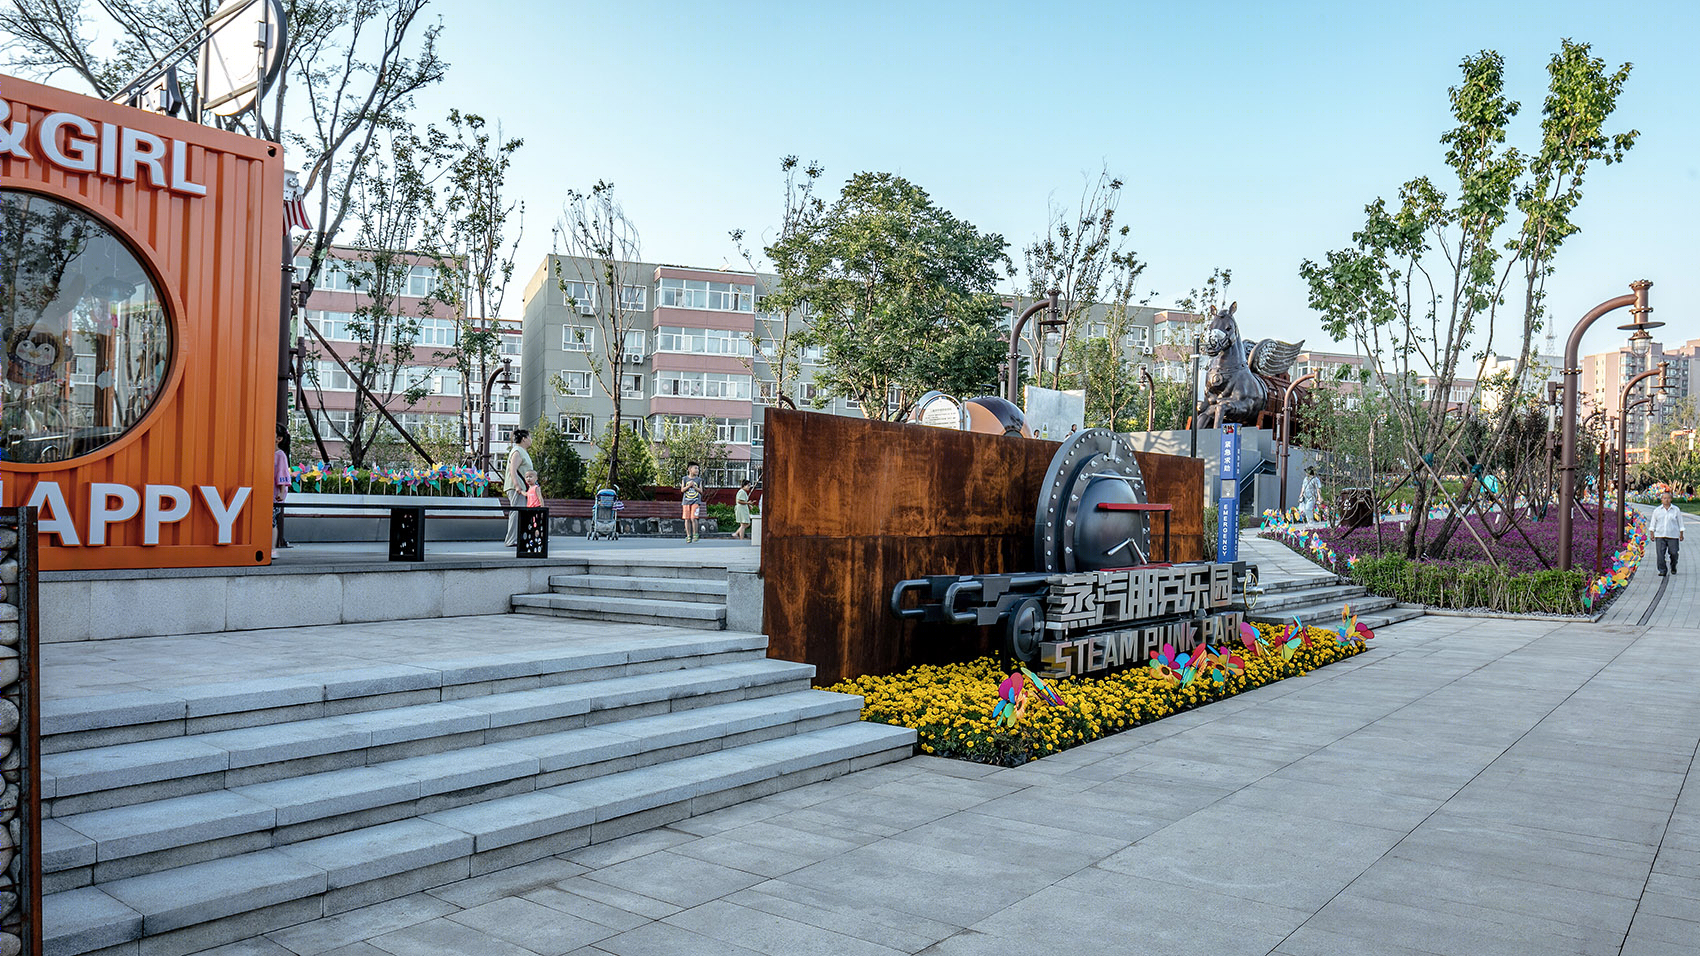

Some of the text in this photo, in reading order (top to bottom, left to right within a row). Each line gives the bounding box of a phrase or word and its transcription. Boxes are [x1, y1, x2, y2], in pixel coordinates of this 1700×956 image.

[1223, 440, 1231, 472] 紧急求助
[0, 480, 252, 545] APPY
[1046, 564, 1233, 630] 蒸汽朋克乐园
[1046, 629, 1139, 679] STEAM
[1143, 619, 1198, 662] PUNK
